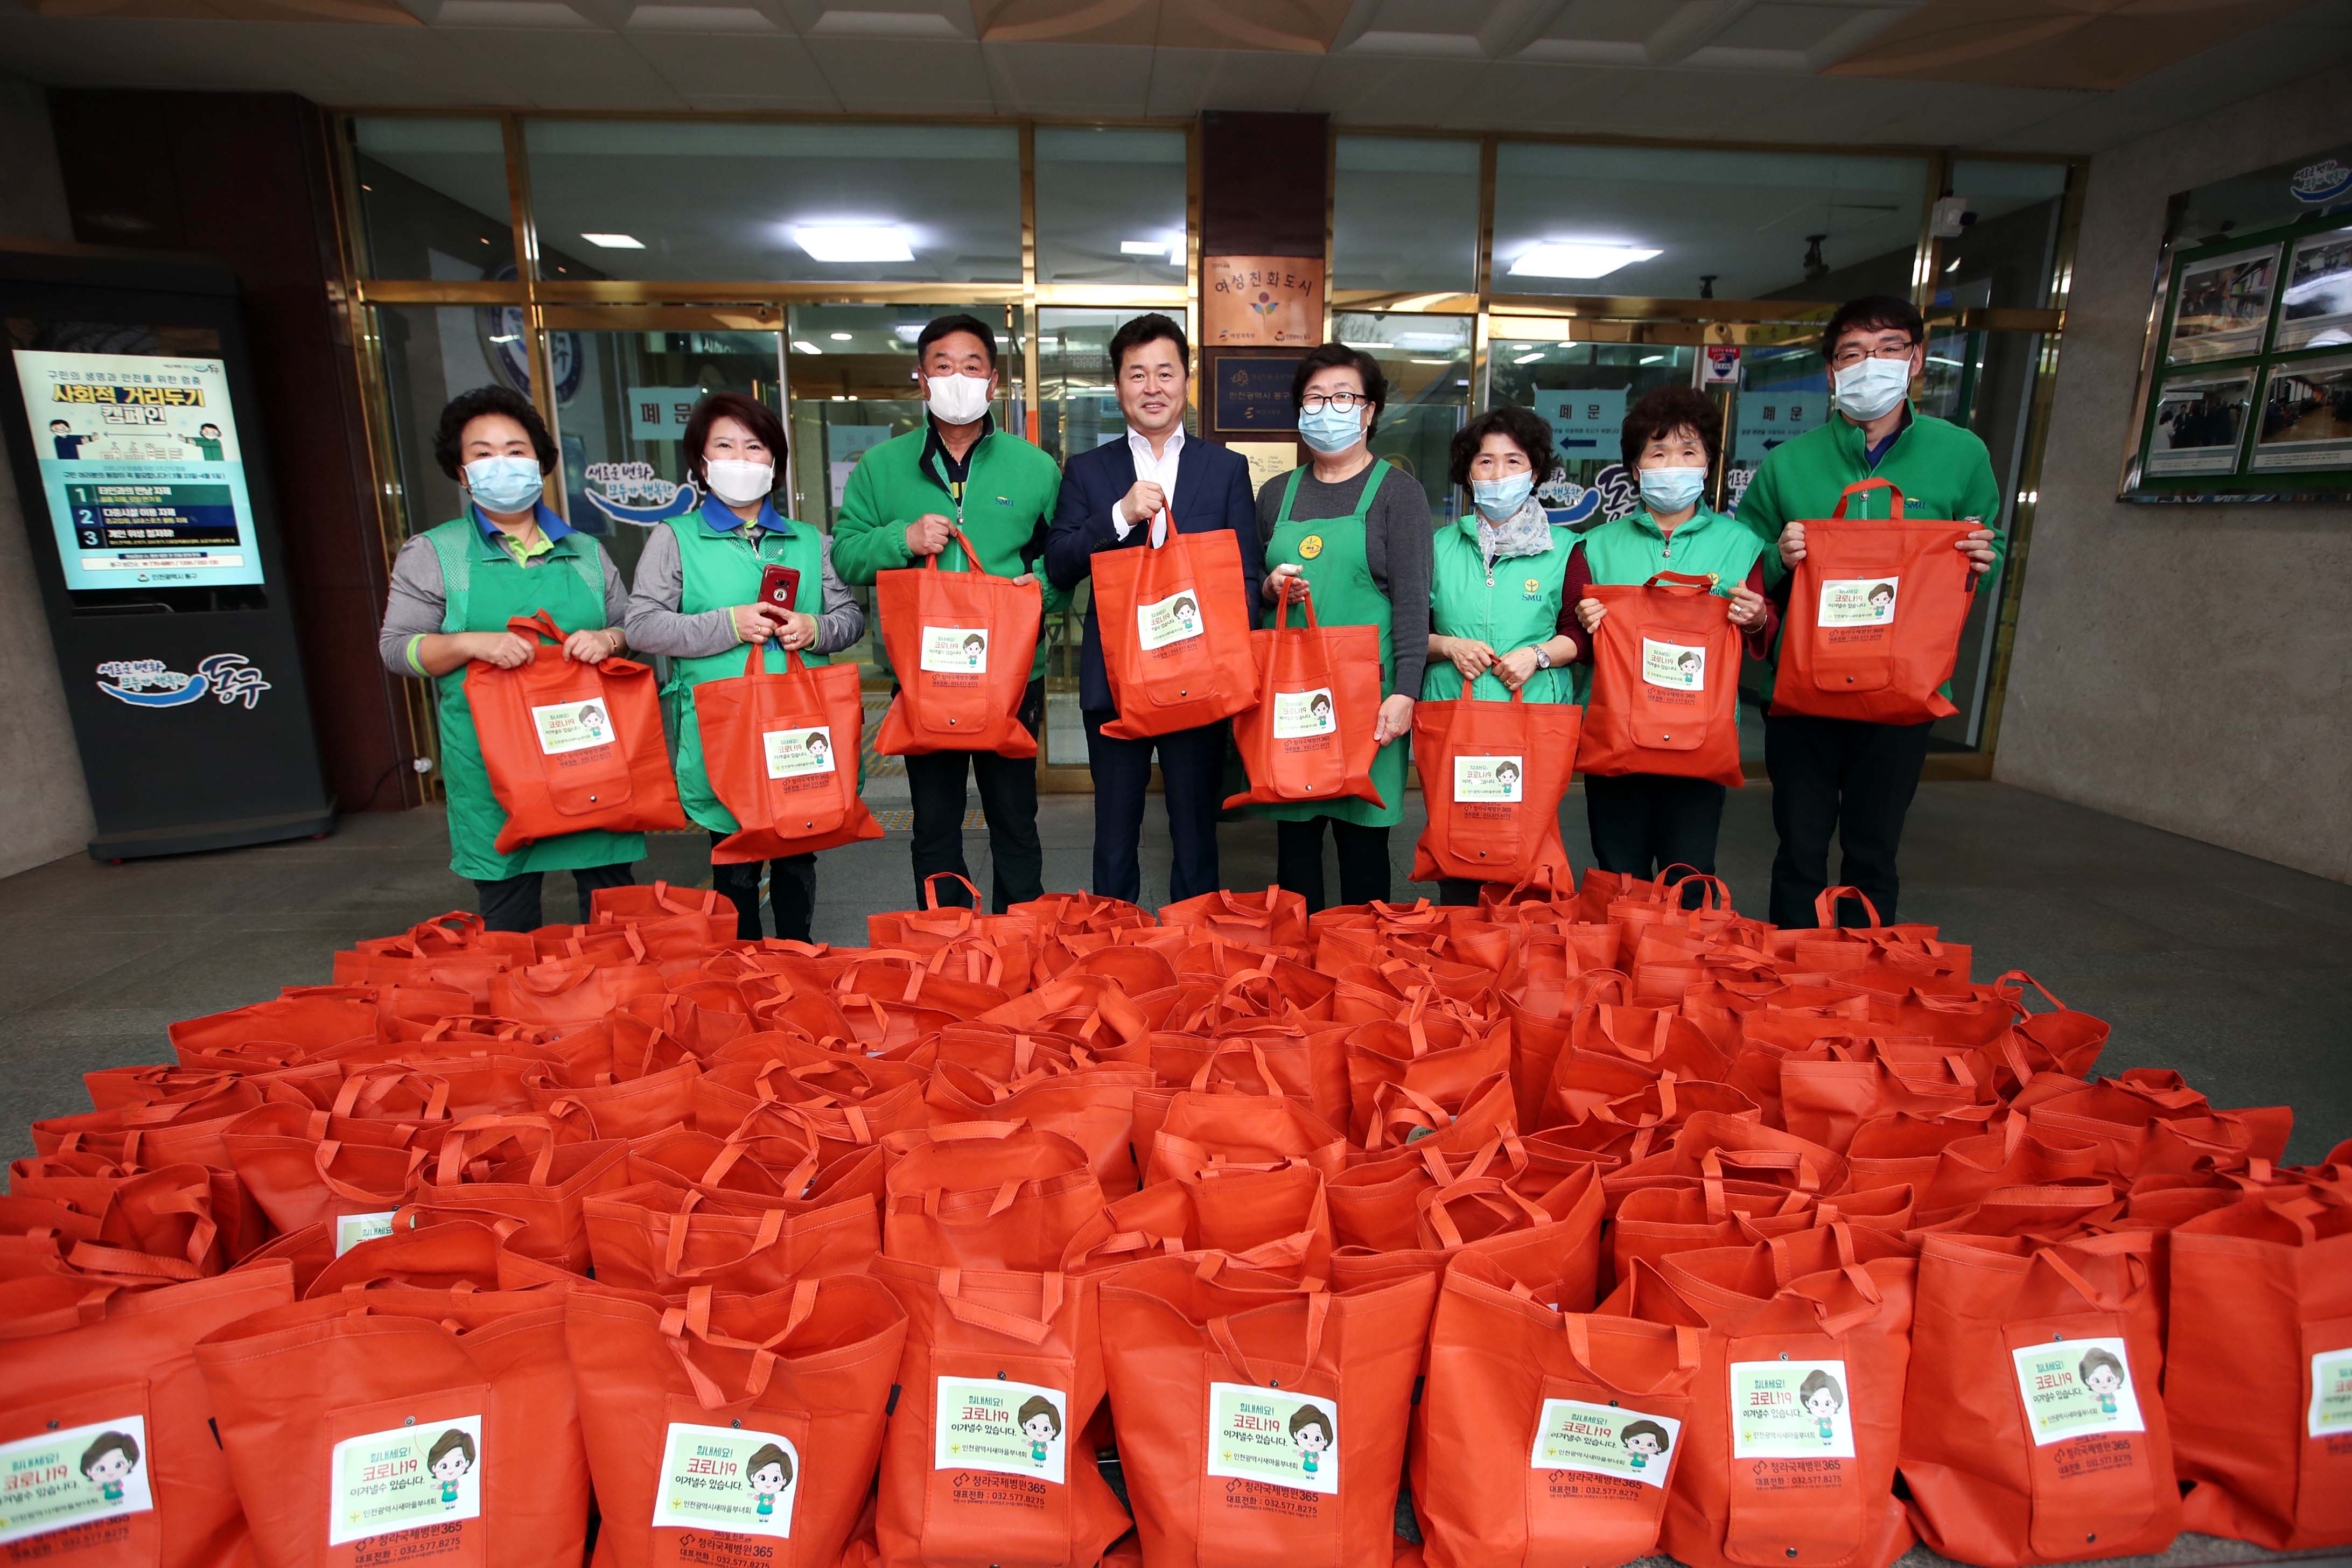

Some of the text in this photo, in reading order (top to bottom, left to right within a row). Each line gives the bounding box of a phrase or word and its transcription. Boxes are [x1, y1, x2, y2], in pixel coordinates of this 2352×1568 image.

[1215, 271, 1312, 296] 여성친화도시
[47, 370, 80, 381] 구민의
[86, 372, 116, 382] 생명과
[158, 375, 177, 384] 위한
[53, 383, 205, 407] 사회적 거리두기
[101, 405, 167, 425] 캠페인
[589, 465, 650, 480] 새로운 변화
[75, 488, 87, 502] 1
[609, 482, 673, 500] 모두가 행복한
[1552, 486, 1581, 504] 행복한
[79, 509, 94, 524] 2
[84, 530, 99, 545] 3
[1151, 613, 1170, 626] 코로나19
[1651, 655, 1674, 664] 코로나19
[99, 661, 164, 676] 새로운 변화
[121, 676, 152, 690] 모두가
[199, 655, 271, 708] 동구
[548, 719, 575, 729] 코로나19
[778, 745, 802, 753] 코로나19
[2036, 1360, 2064, 1373] 힘내세요!
[1754, 1380, 1786, 1389] 힘내세요!
[2035, 1373, 2073, 1390] 코로나19
[969, 1396, 1004, 1406] 힘내세요!
[1750, 1392, 1792, 1405] 코로나19
[2033, 1388, 2083, 1403] 이겨낼수 있습니다.
[962, 1406, 1009, 1423] 코로나19
[1240, 1403, 1274, 1416] 힘내세요!
[1743, 1408, 1803, 1419] 이겨낼수 있습니다.
[1233, 1414, 1280, 1432] 코로나19
[1571, 1413, 1607, 1426] 힘내세요!
[951, 1424, 1017, 1437] 이겨낼수 있습니다.
[1562, 1421, 1612, 1438] 코로나19
[1753, 1431, 1816, 1439] 인천광역시새마을부녀회
[1223, 1430, 1288, 1447] 이겨낼수 있습니다.
[1551, 1432, 1617, 1448] 이겨낼수 있습니다.
[370, 1446, 411, 1463] 힘내세요!
[697, 1445, 733, 1458] 힘내세요!
[962, 1444, 1027, 1458] 인천광역시새마을부녀회
[1558, 1449, 1625, 1466] 인천광역시새마을부녀회
[687, 1458, 737, 1476] 코로나19
[1233, 1453, 1298, 1469] 인천광역시새마을부녀회
[1770, 1460, 1840, 1473] 청라국제병원365
[362, 1459, 417, 1482] 코로나19
[4, 1465, 68, 1492] 코로나19
[350, 1475, 425, 1497] 이겨낼수 있습니다.
[675, 1475, 743, 1491] 이겨낼수 있습니다.
[972, 1476, 1046, 1494] 청라국제병원365
[1567, 1472, 1642, 1489] 청라국제병원365
[1755, 1478, 1784, 1486] 대표전화
[953, 1490, 984, 1500] 대표전화
[992, 1492, 1045, 1505] 032.577.8275
[1245, 1481, 1319, 1502] 청라국제병원365
[1549, 1485, 1578, 1494] 대표전화
[1586, 1487, 1639, 1498] 032.577.8275
[363, 1498, 437, 1518] 인천광역시새마을부녀회
[683, 1500, 751, 1514] 인천광역시새마을부녀회
[1227, 1495, 1257, 1504] 대표전화
[1264, 1499, 1317, 1514] 032.577.8275
[355, 1550, 391, 1564] 대표전화
[400, 1537, 460, 1556] 032.577.8275
[680, 1548, 709, 1560] 대표전화
